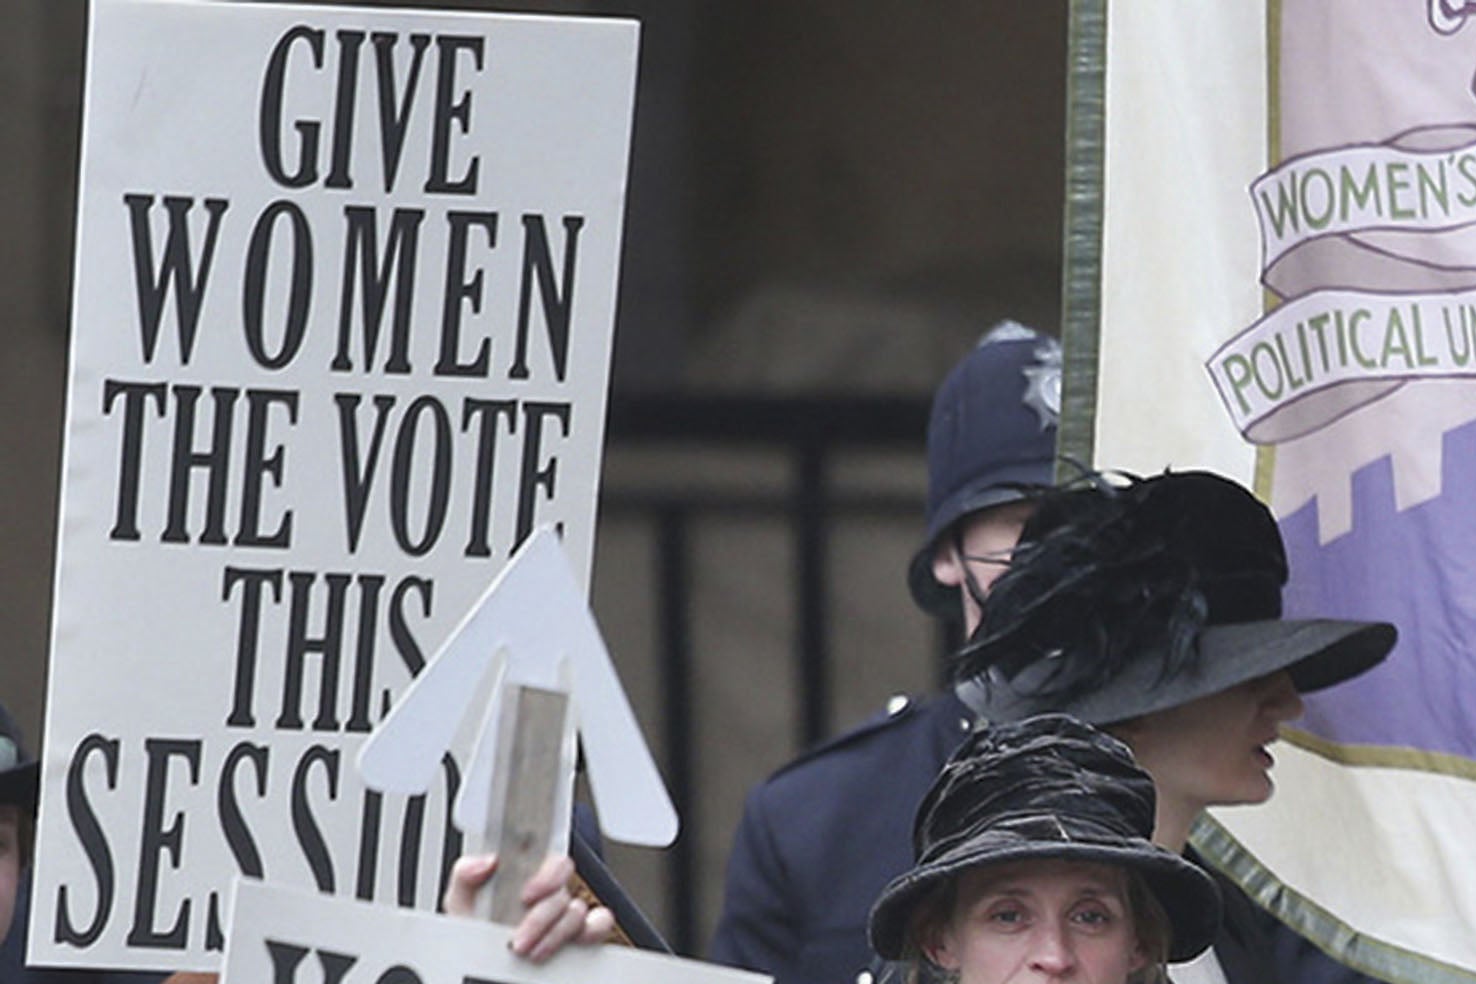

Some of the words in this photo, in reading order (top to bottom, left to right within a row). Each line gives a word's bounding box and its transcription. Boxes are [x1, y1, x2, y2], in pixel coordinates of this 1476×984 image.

[260, 25, 485, 196] GIVE
[123, 194, 584, 382] WOMEN
[1222, 304, 1437, 415] POLITICAL
[104, 379, 299, 549] THE
[334, 393, 571, 558] VOTE
[223, 567, 434, 733] THIS
[54, 733, 585, 950] SESSIO
